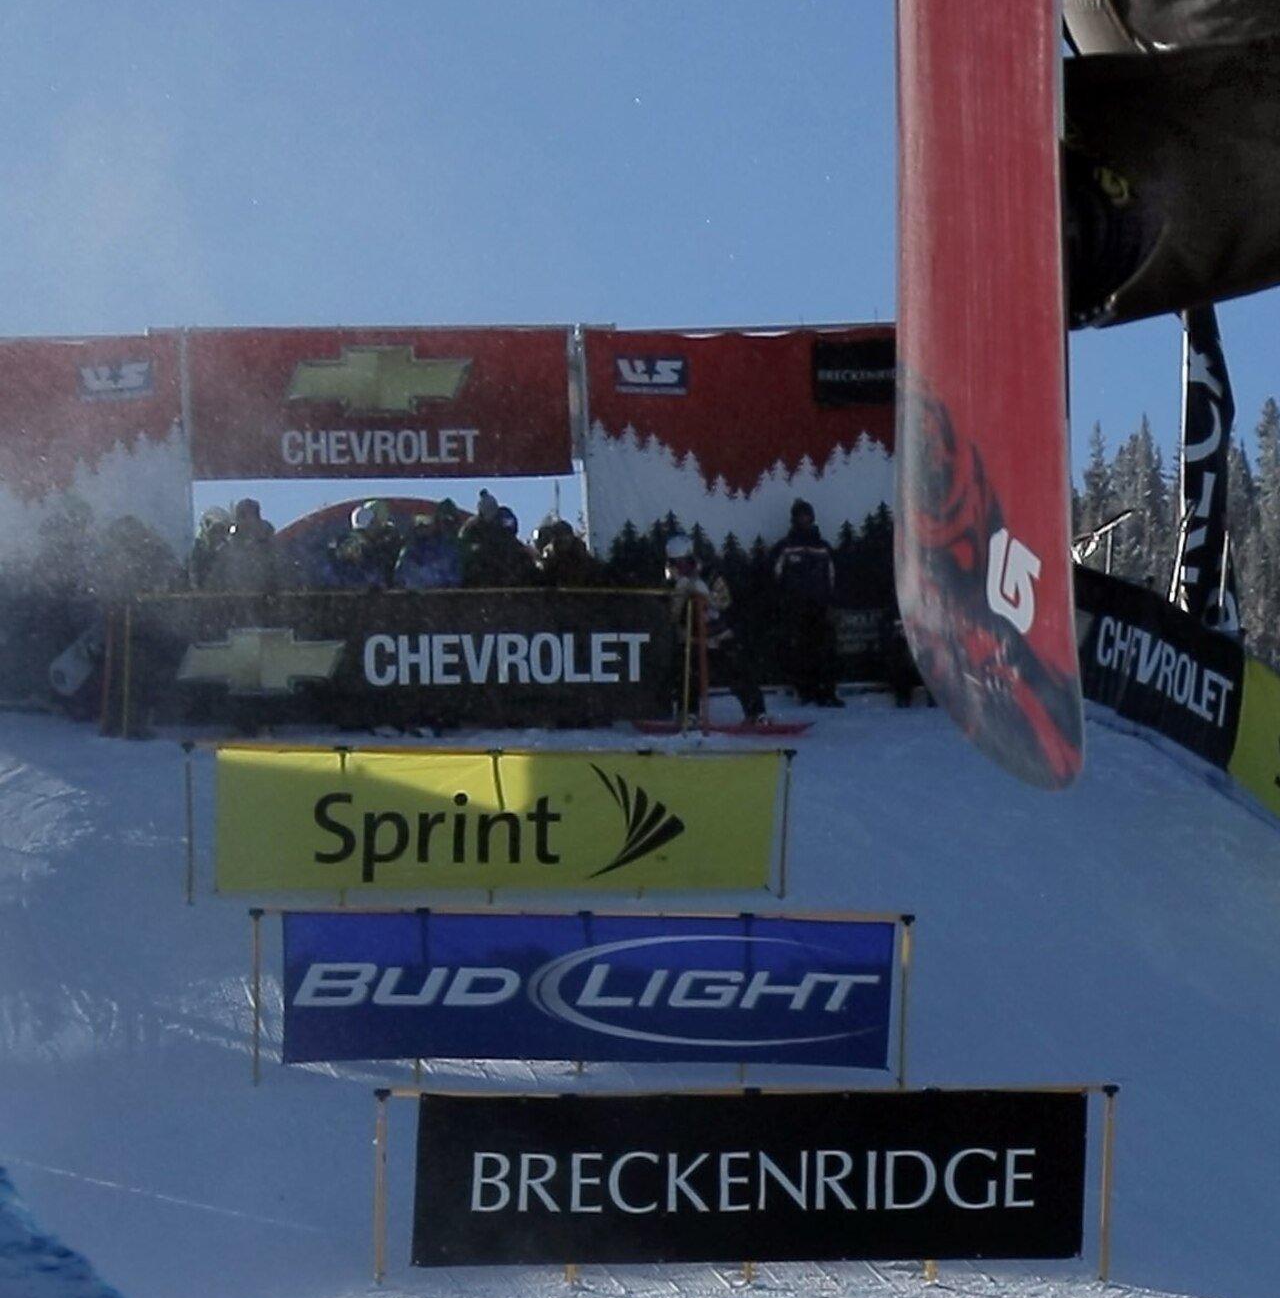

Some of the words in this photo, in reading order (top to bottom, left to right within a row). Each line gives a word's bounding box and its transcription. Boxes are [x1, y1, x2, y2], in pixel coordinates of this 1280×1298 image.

[282, 429, 481, 465] CHEVROLET
[363, 632, 651, 687] CHEVROLET
[1096, 615, 1235, 729] CHEVROLET
[313, 791, 562, 883] Sprint
[292, 961, 534, 1008] BUD
[575, 968, 881, 1013] LIGHT
[469, 1147, 1038, 1214] BRECKENRIDGE
